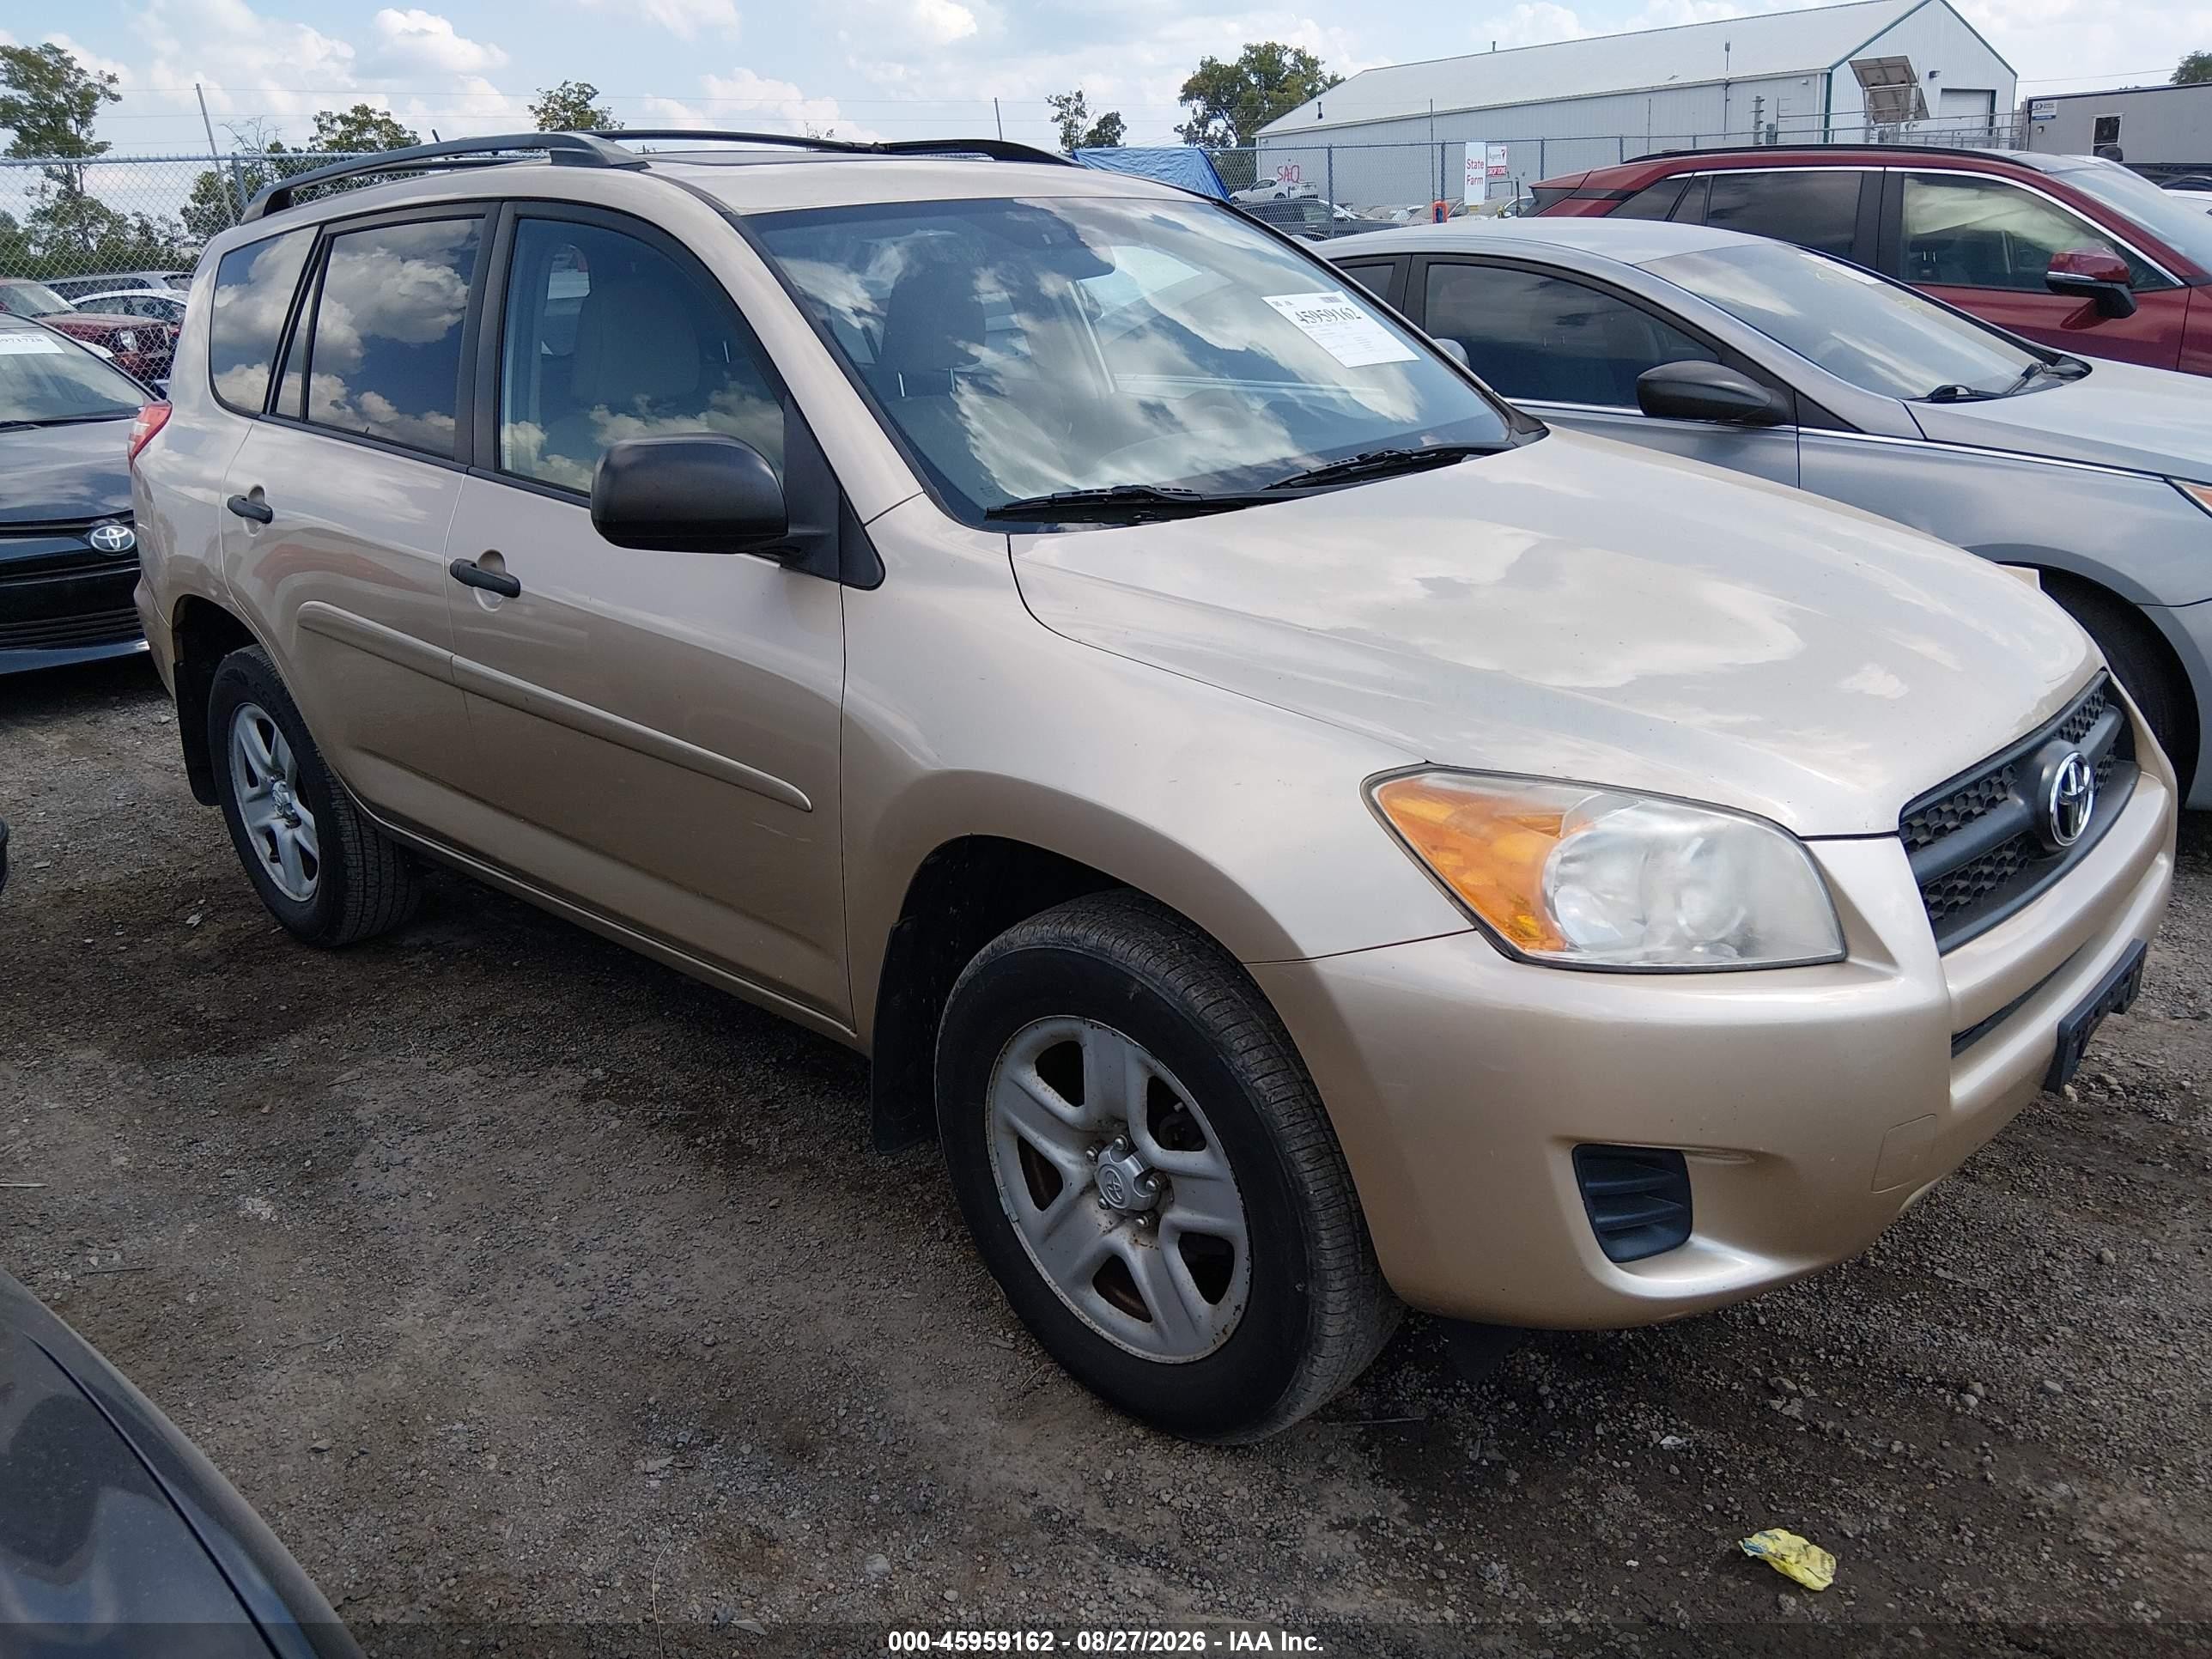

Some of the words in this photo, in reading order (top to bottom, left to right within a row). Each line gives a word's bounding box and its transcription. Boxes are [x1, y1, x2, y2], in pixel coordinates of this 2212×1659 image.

[1467, 158, 1485, 170] State
[1467, 174, 1484, 185] Farm
[1295, 307, 1362, 324] 45959162
